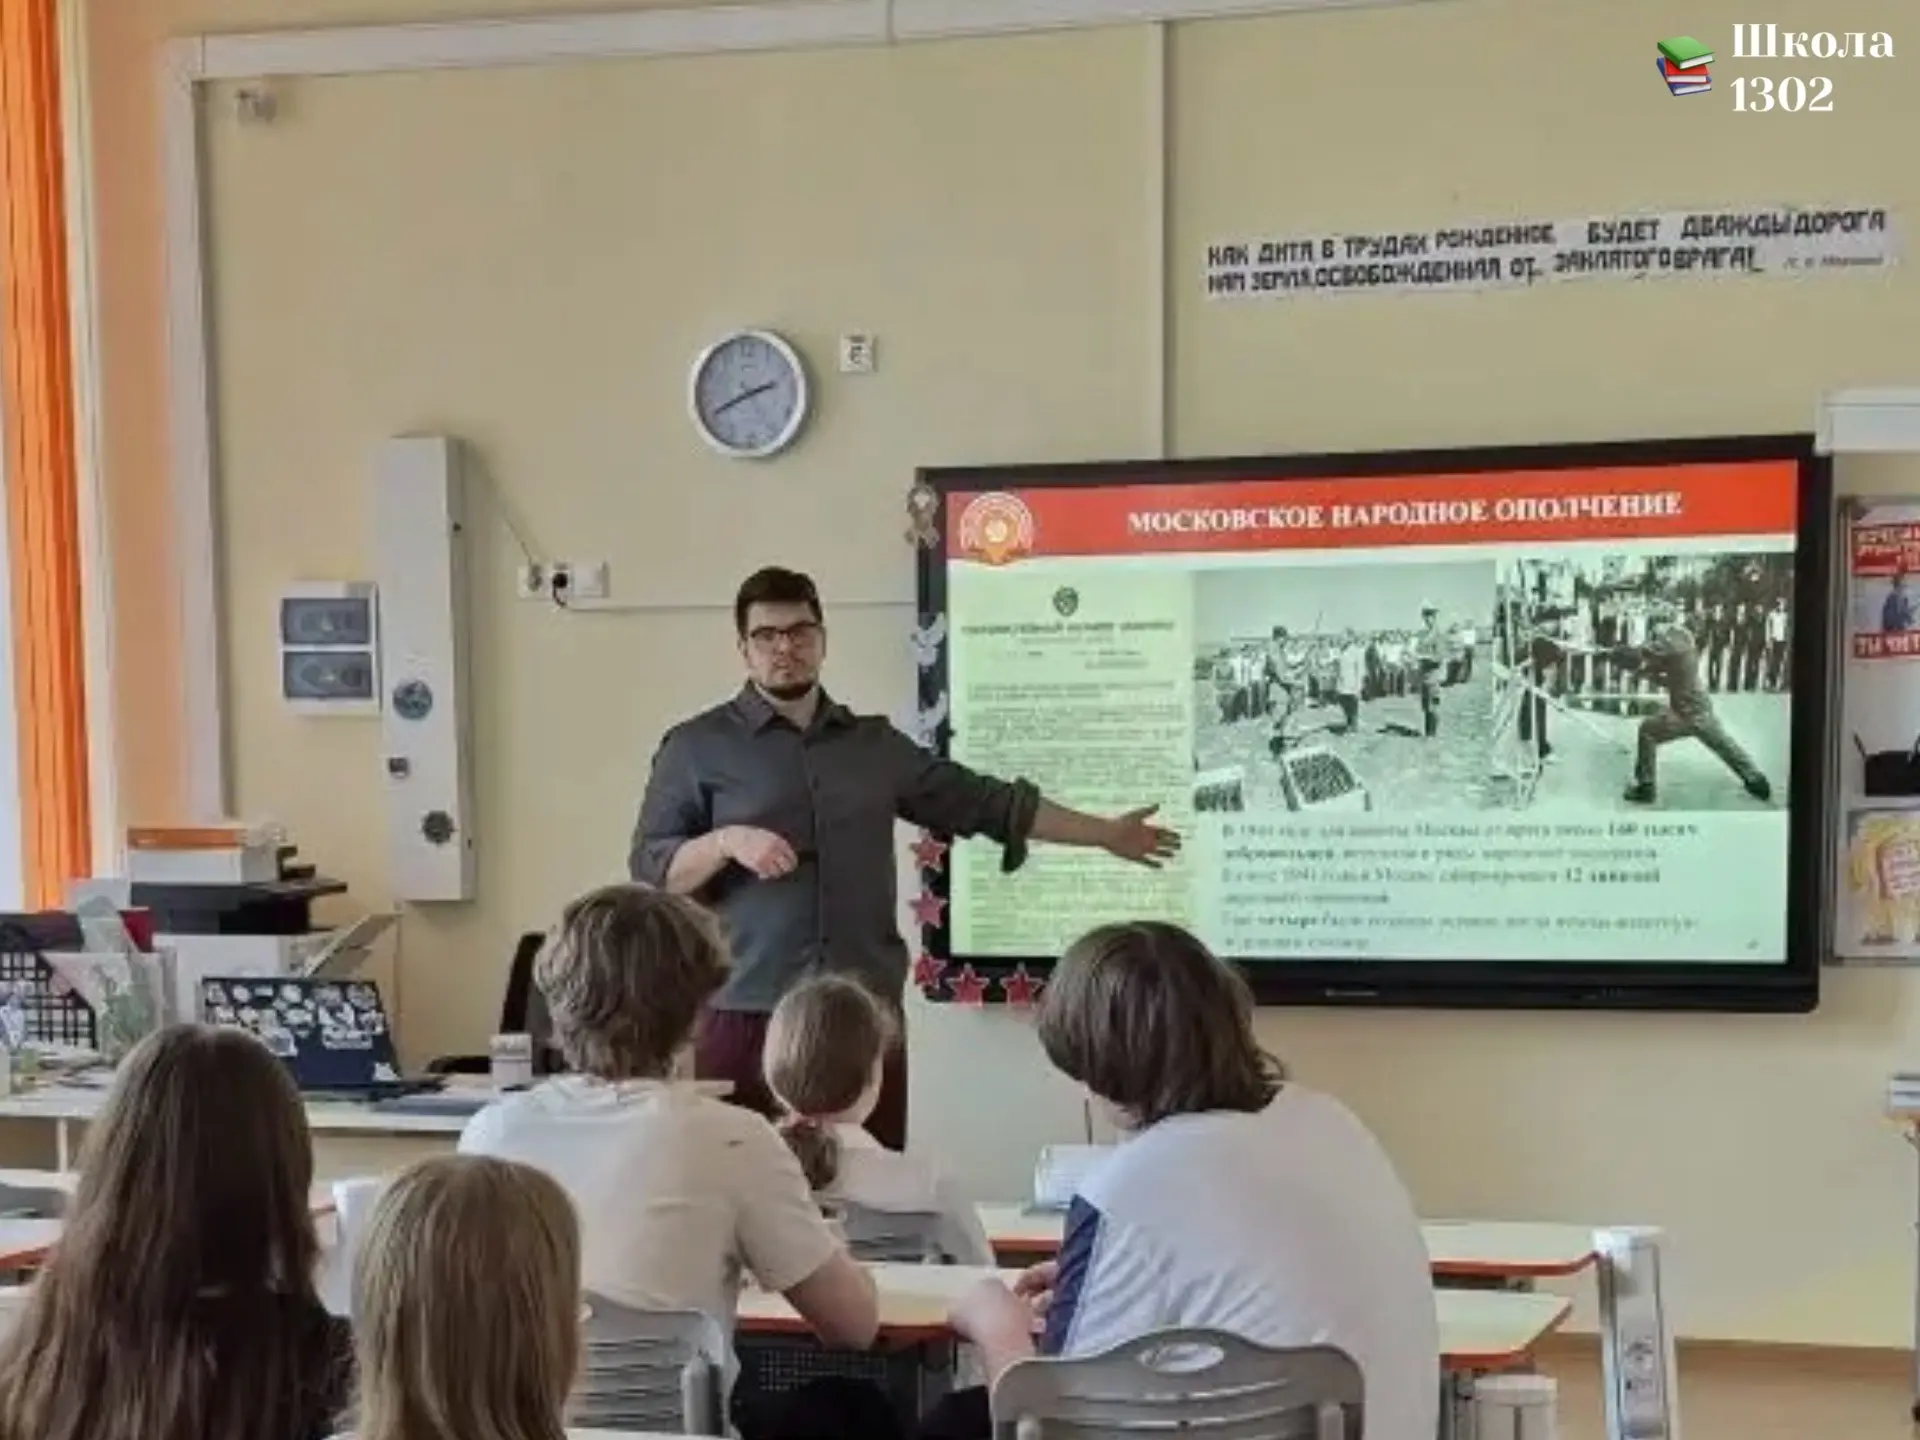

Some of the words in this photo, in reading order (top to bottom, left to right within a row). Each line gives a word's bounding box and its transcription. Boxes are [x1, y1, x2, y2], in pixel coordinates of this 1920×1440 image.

[1208, 244, 1249, 267] КАК
[1258, 239, 1313, 264] ДИТЯ
[1321, 240, 1335, 259] В
[1344, 233, 1429, 259] ТРУДАХ
[1587, 218, 1661, 245] БУДЕТ
[1680, 212, 1791, 241] ДВАЖДЫ
[1793, 209, 1886, 238] ДОРОГА
[1128, 505, 1324, 533] МОСКОВСКОЕ
[1332, 499, 1488, 529] НАРОДНОЕ
[1495, 491, 1682, 522] ОПОЛЧЕНИЕ
